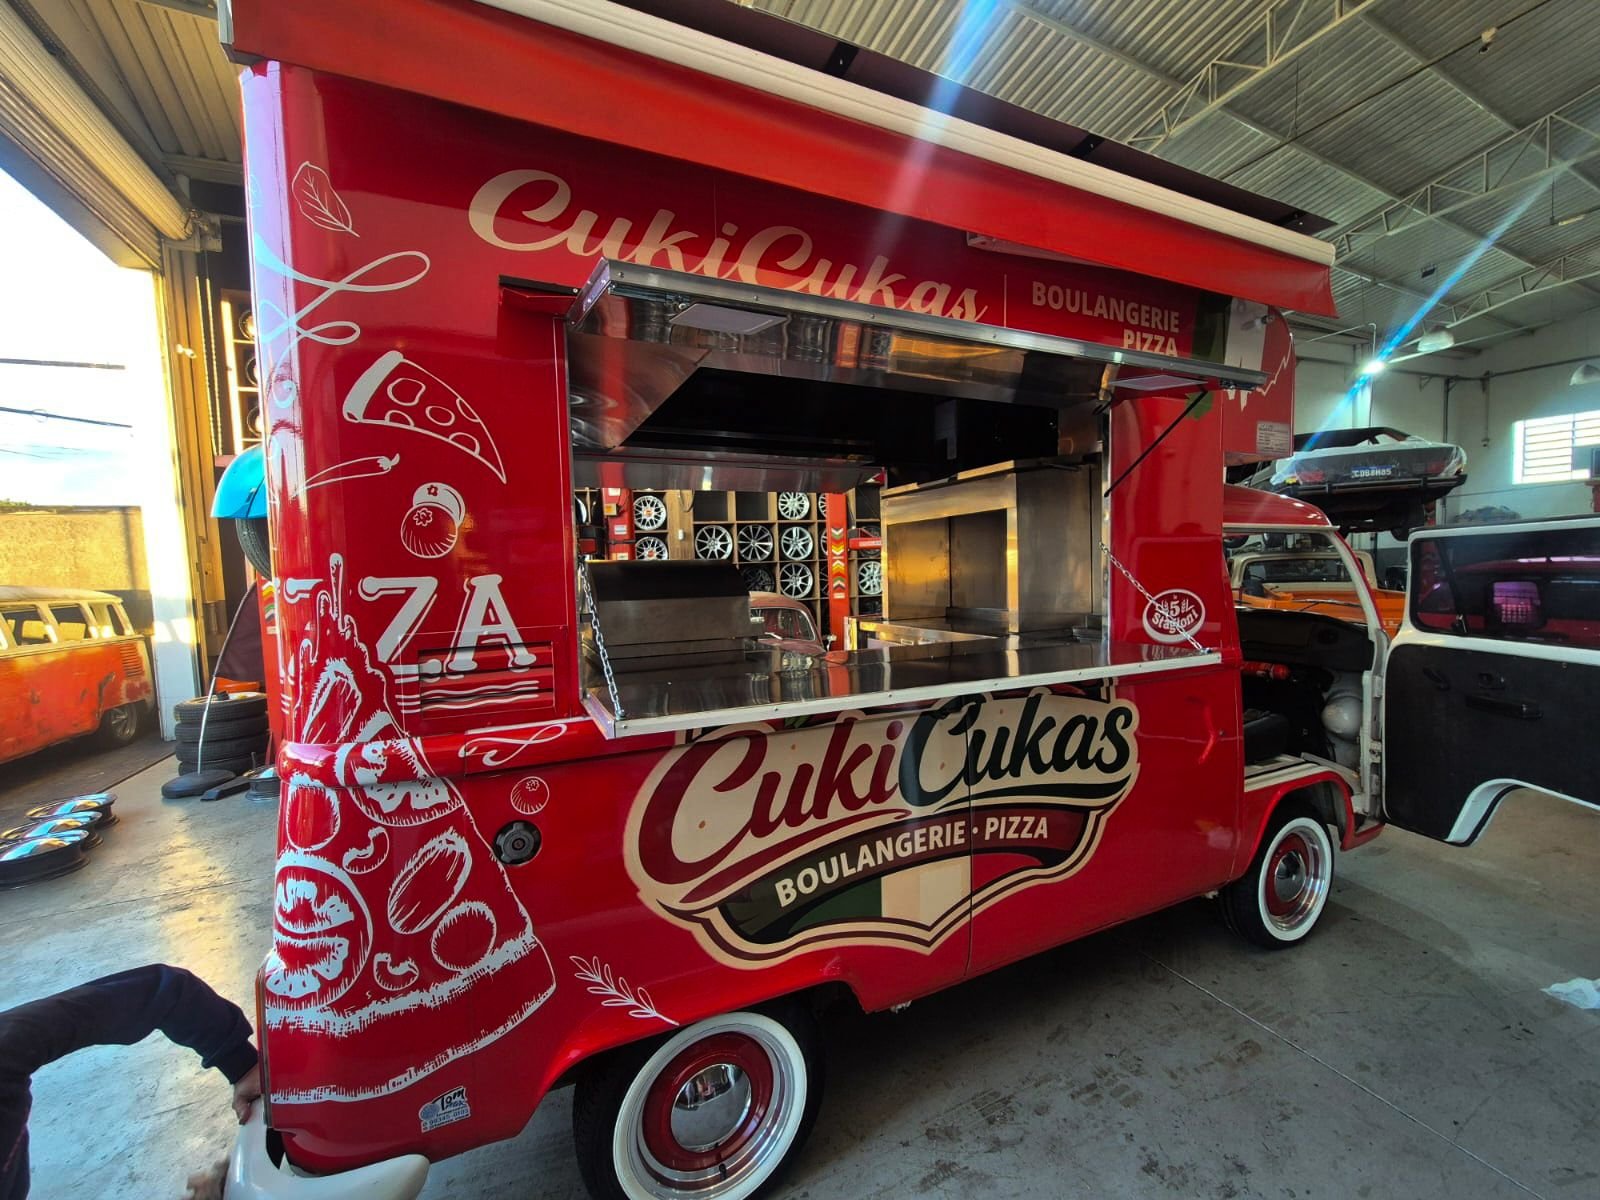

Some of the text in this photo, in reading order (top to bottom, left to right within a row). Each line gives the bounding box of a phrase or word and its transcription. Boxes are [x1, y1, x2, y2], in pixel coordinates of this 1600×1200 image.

[1032, 280, 1180, 333] BOULANGERIE
[1122, 328, 1179, 358] PIZZA
[1169, 600, 1181, 617] 5
[774, 816, 1049, 908] BOULANGERIE PIZZA
